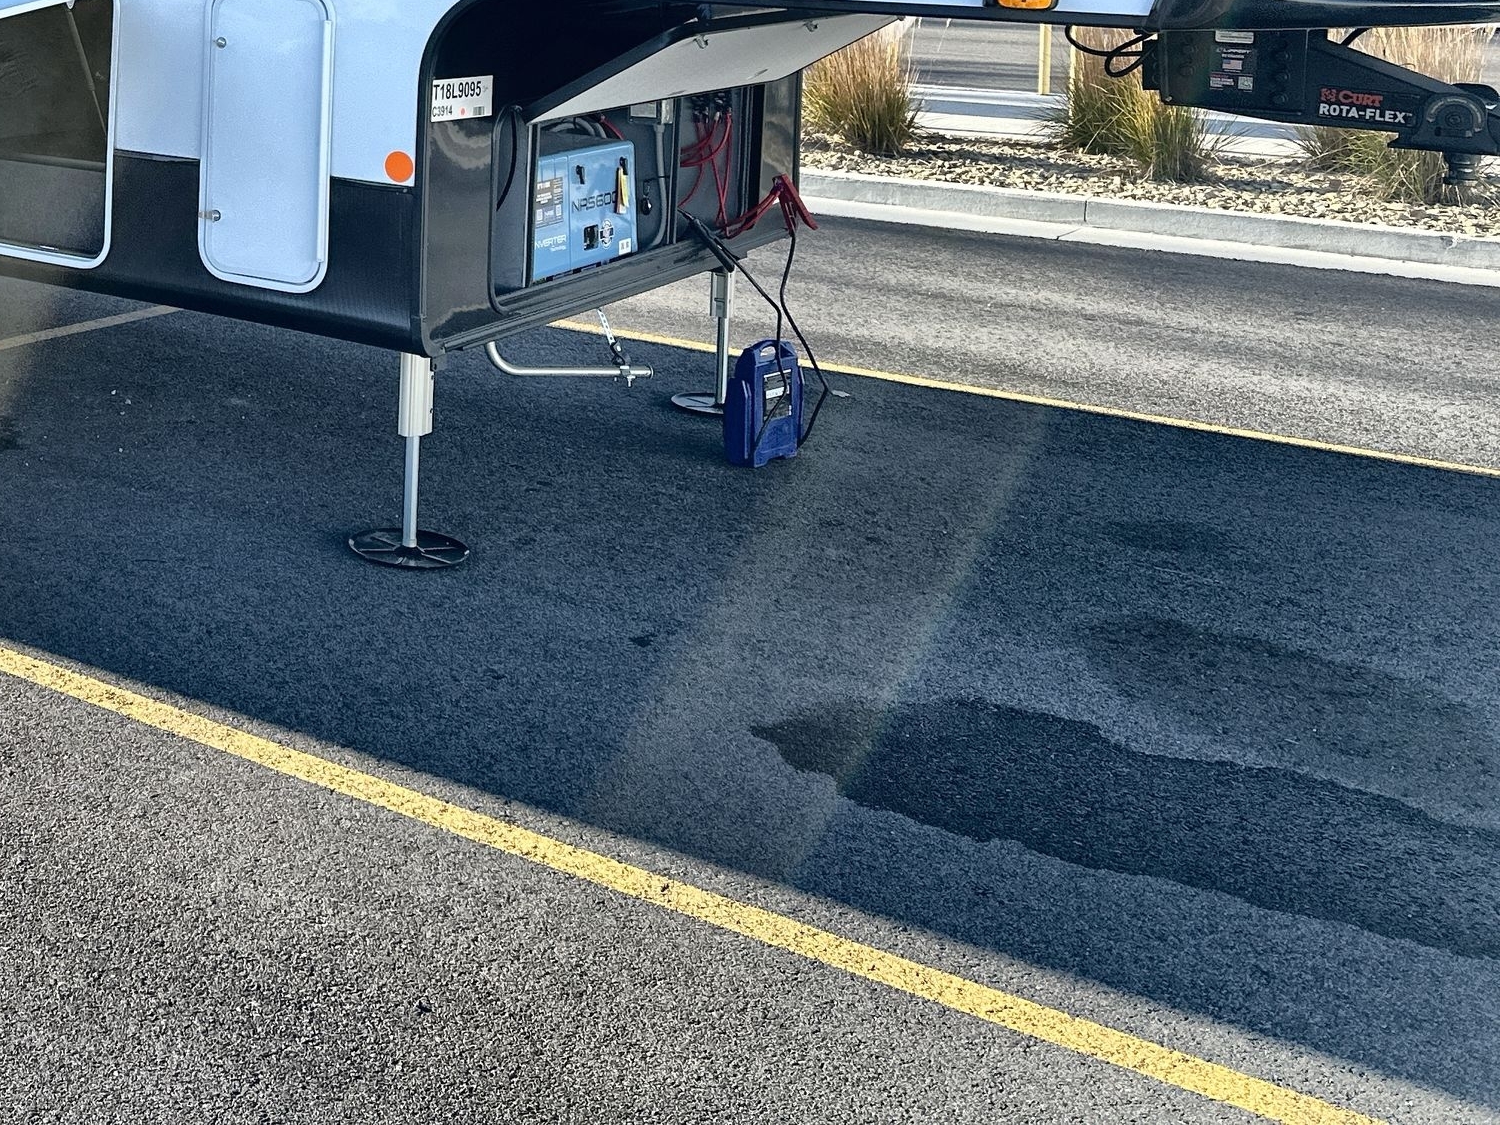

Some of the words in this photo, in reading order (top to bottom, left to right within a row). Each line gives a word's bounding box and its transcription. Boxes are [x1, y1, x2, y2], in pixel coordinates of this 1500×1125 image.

[433, 81, 481, 100] T18L9095
[1339, 90, 1383, 107] CURT
[432, 105, 453, 117] C3914
[535, 234, 567, 249] NVERTER
